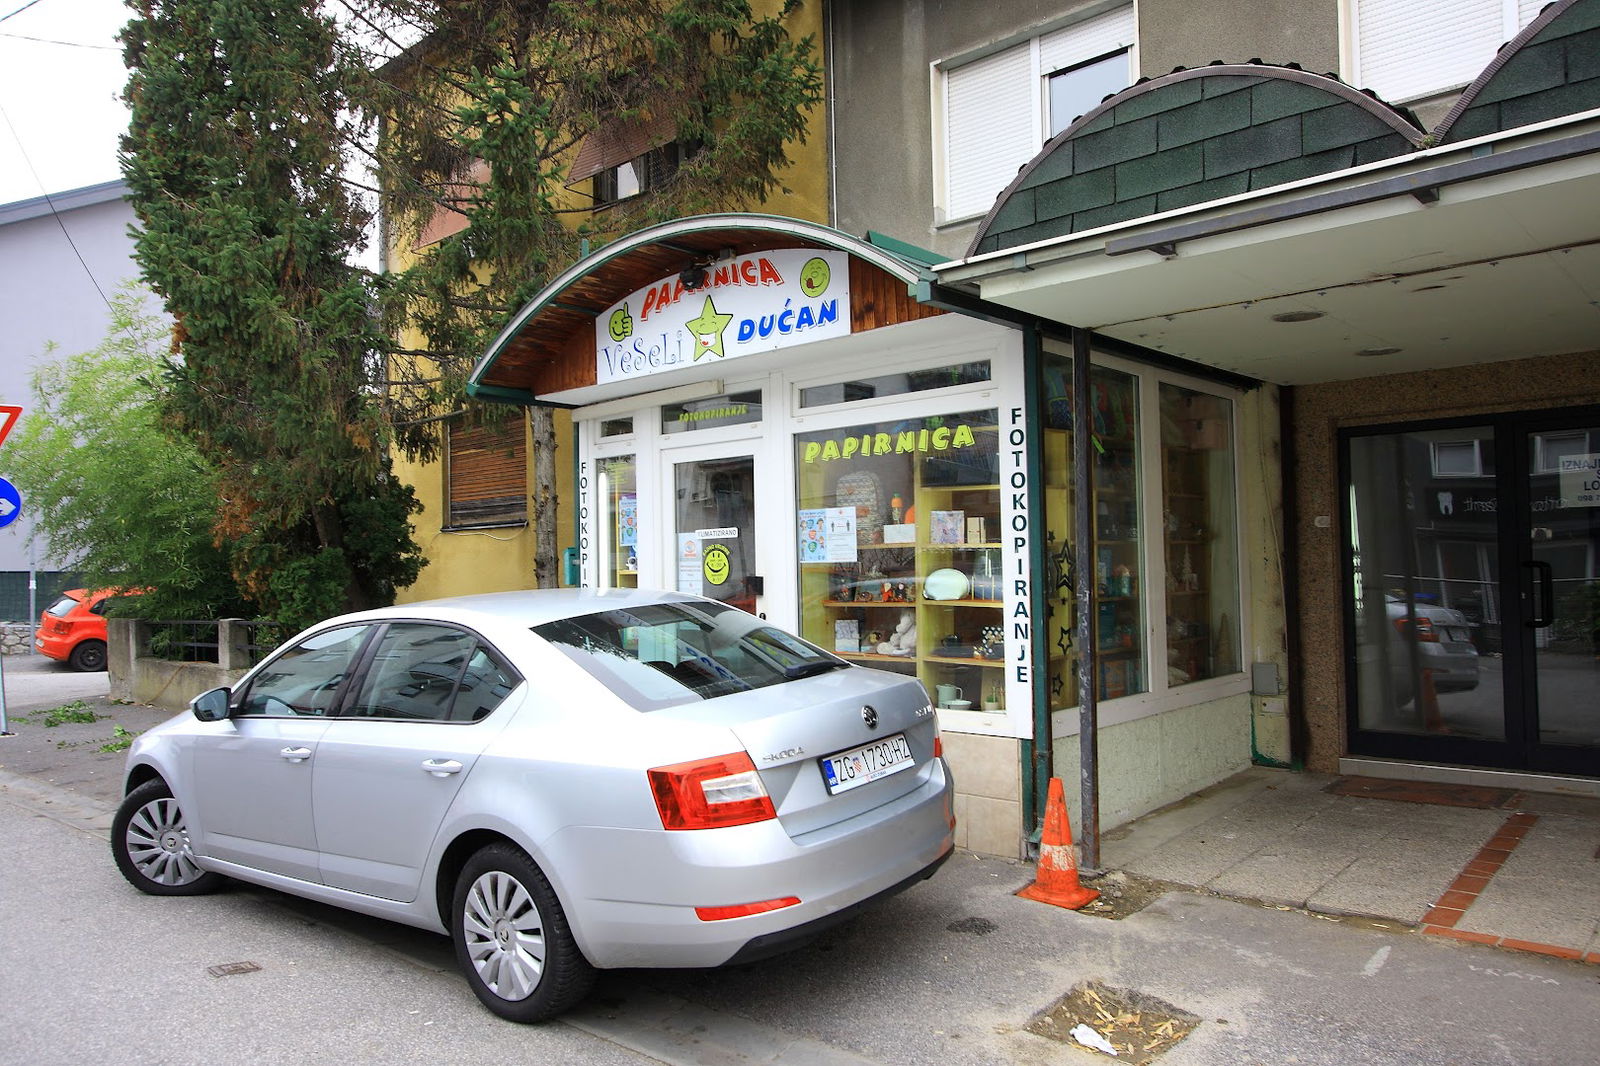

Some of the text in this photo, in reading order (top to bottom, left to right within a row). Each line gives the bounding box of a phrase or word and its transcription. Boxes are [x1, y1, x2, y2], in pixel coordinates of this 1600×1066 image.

[737, 298, 839, 344] DUĆAN
[804, 424, 975, 464] PAPIRNICA
[1562, 458, 1600, 470] IZNAJ
[1009, 407, 1029, 683] FOTOKOPIRANJE
[834, 756, 855, 782] ZG
